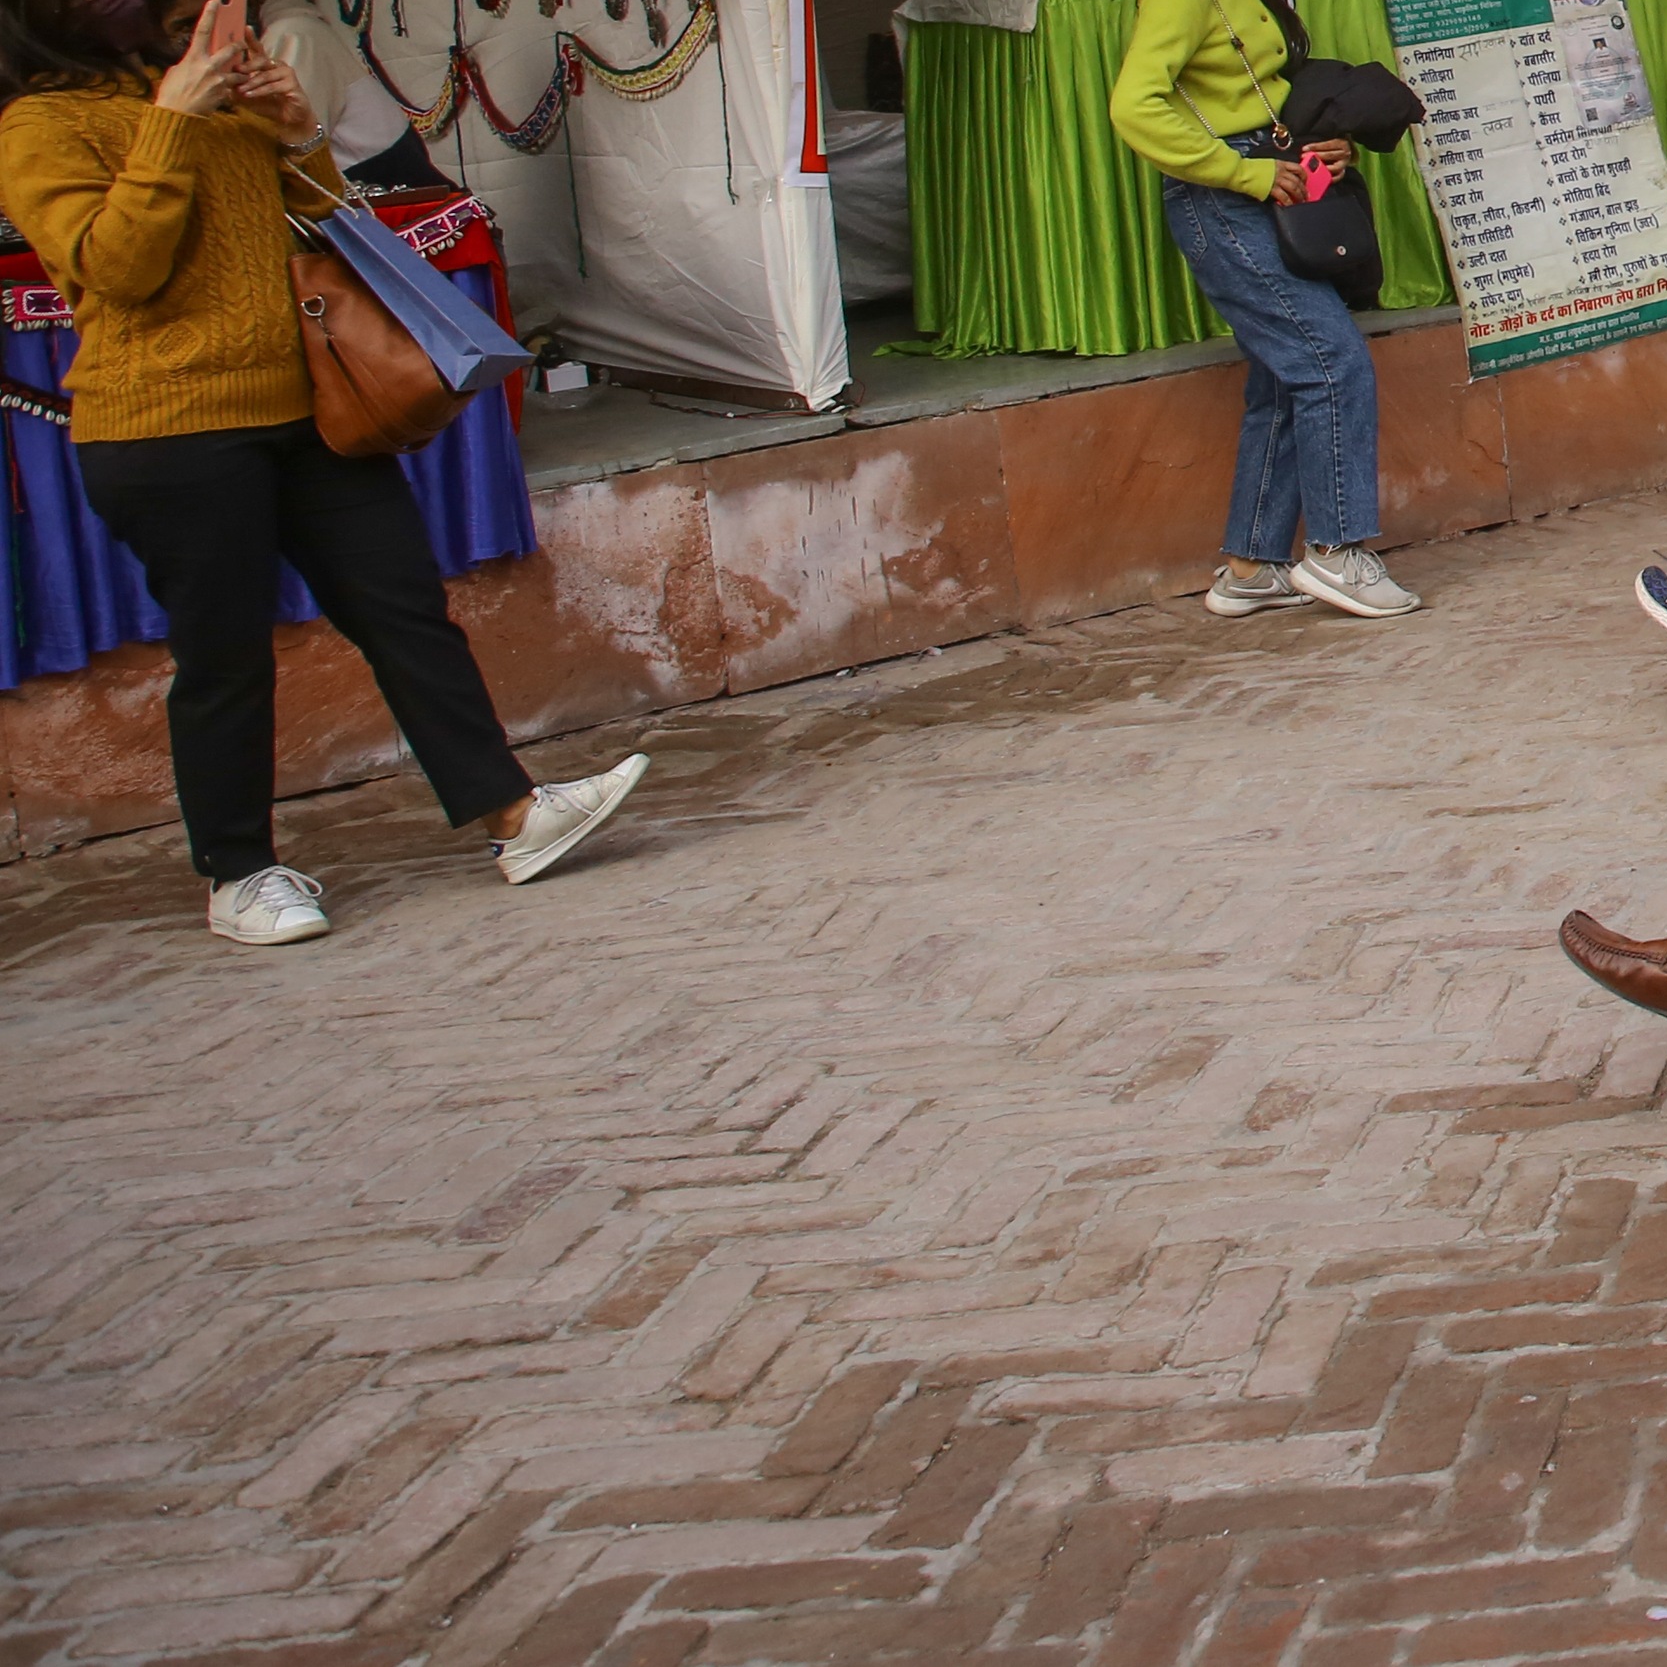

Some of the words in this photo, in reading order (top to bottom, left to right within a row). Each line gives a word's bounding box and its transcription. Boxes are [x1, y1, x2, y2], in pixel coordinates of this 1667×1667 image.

[1538, 30, 1553, 43] दर्द
[1414, 47, 1456, 64] निमोनिया
[1528, 70, 1561, 87] पीलिया
[1570, 146, 1587, 161] रोग
[1579, 165, 1590, 179] के
[1590, 162, 1607, 177] रोग
[1449, 195, 1466, 208] उदर
[1468, 189, 1484, 203] रोग
[1562, 187, 1595, 204] मोतिया
[1601, 244, 1618, 257] रोग
[1649, 253, 1660, 267] के
[1498, 313, 1524, 332] जोड़ों
[1526, 311, 1537, 326] के
[1540, 307, 1555, 323] दर्द
[1556, 304, 1572, 317] का
[1574, 296, 1613, 314] निवारण
[1616, 289, 1633, 305] लेप
